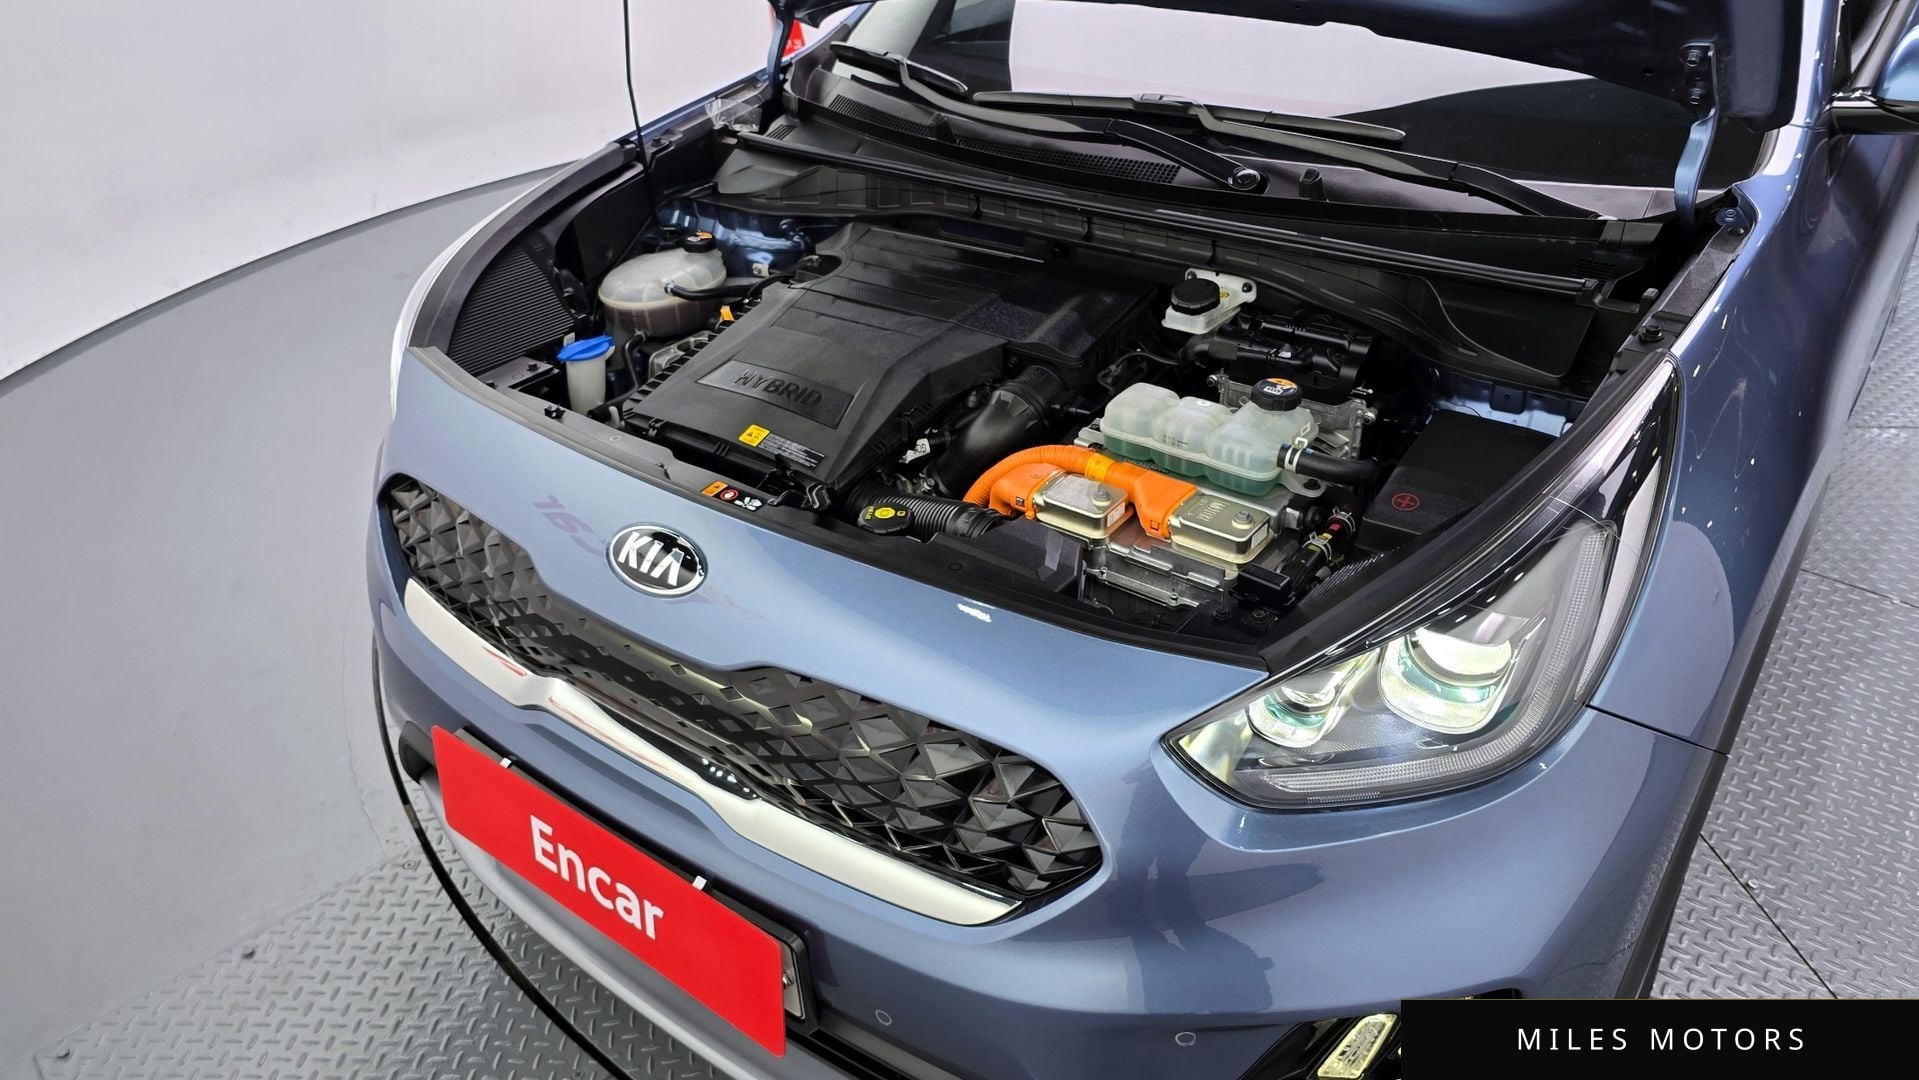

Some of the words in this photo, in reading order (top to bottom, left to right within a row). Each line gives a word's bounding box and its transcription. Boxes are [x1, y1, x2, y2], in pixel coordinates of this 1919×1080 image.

[734, 369, 823, 407] HYBRID
[617, 531, 685, 587] KIA
[530, 814, 664, 940] Encar
